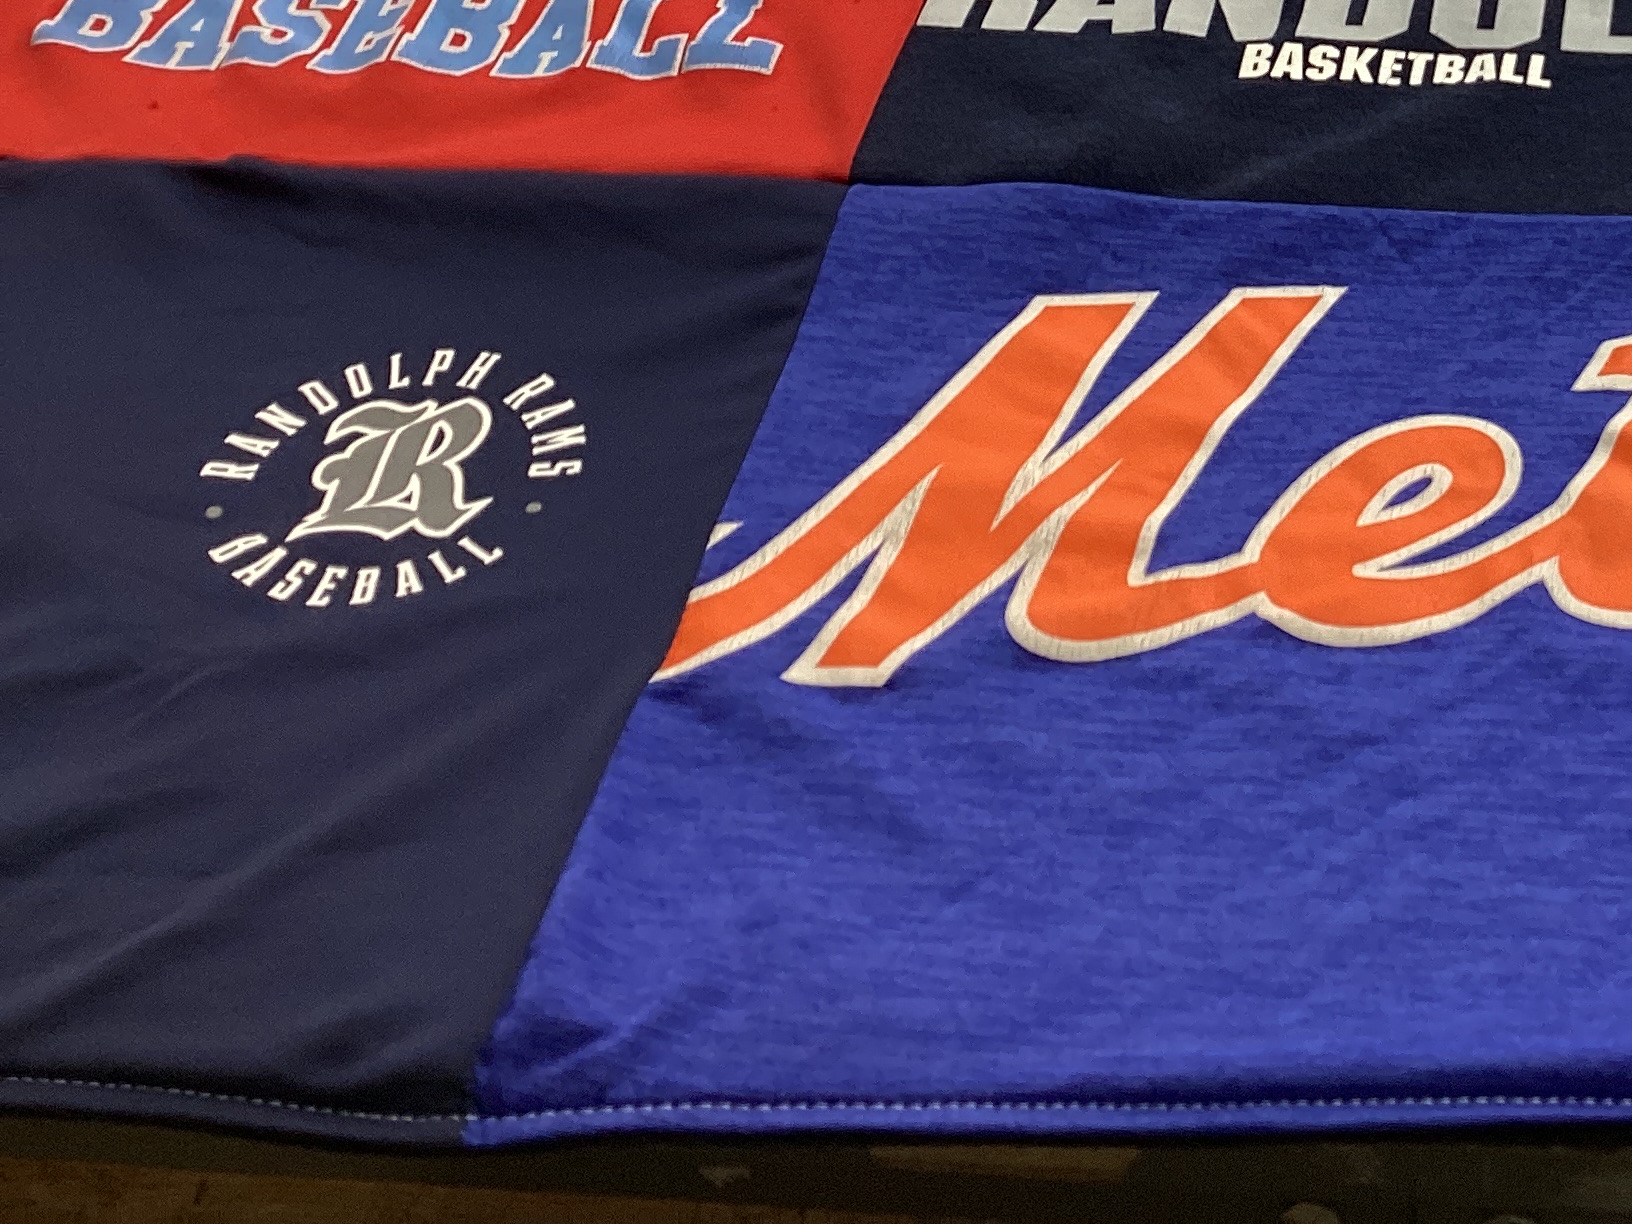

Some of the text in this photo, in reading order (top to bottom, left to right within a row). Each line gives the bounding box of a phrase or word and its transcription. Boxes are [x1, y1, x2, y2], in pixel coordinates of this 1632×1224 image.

[1236, 40, 1553, 90] BASKETBALL
[199, 346, 588, 482] RANDOLPH RAMS
[206, 532, 504, 608] BASEBALL
